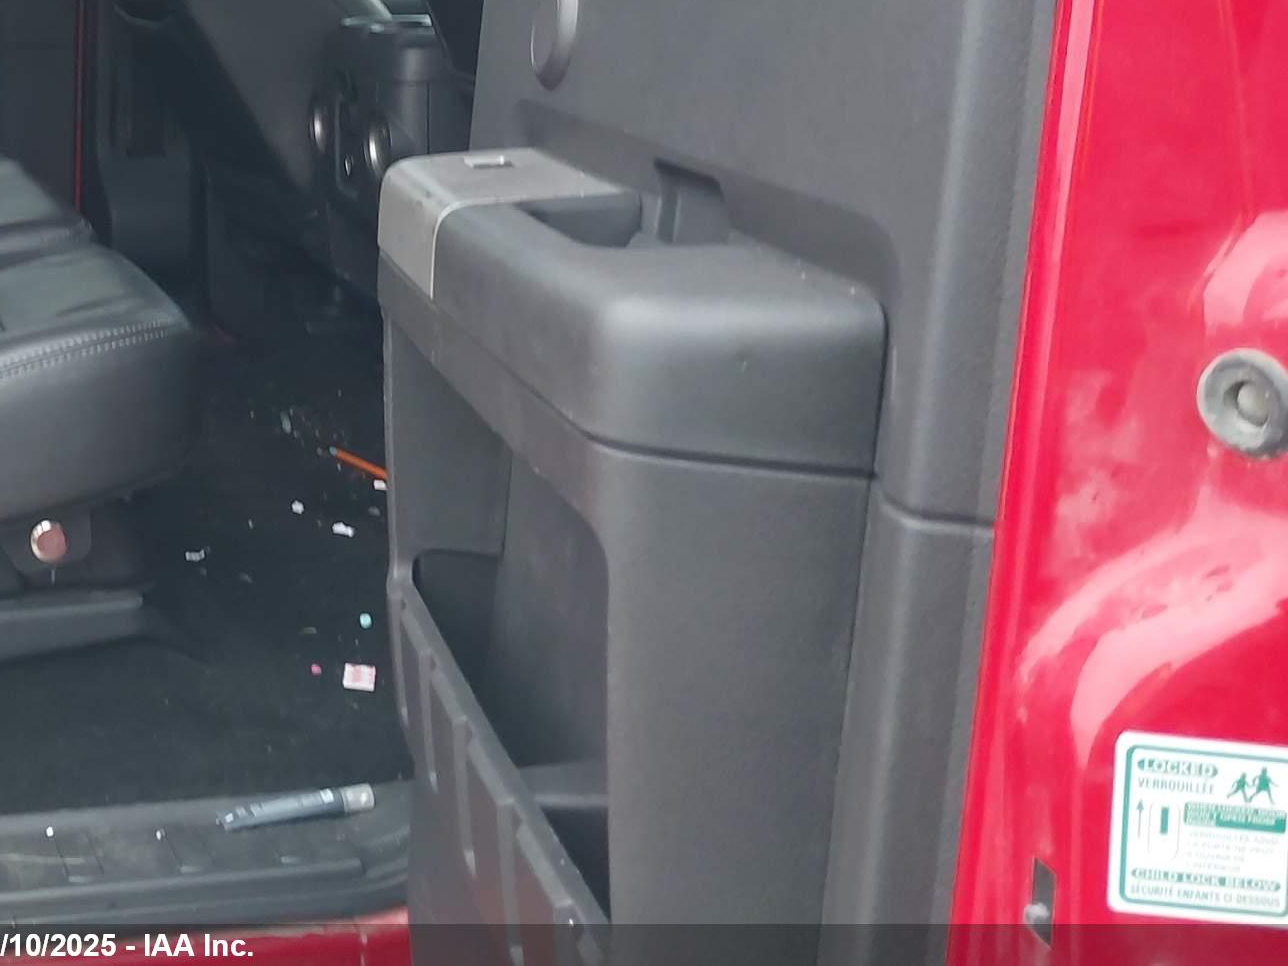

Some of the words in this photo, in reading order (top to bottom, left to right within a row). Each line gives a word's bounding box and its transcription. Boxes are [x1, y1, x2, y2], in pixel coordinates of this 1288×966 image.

[1143, 759, 1213, 777] LOCKED
[1182, 873, 1218, 886] LOCK
[1177, 887, 1220, 902] ENFANTS
